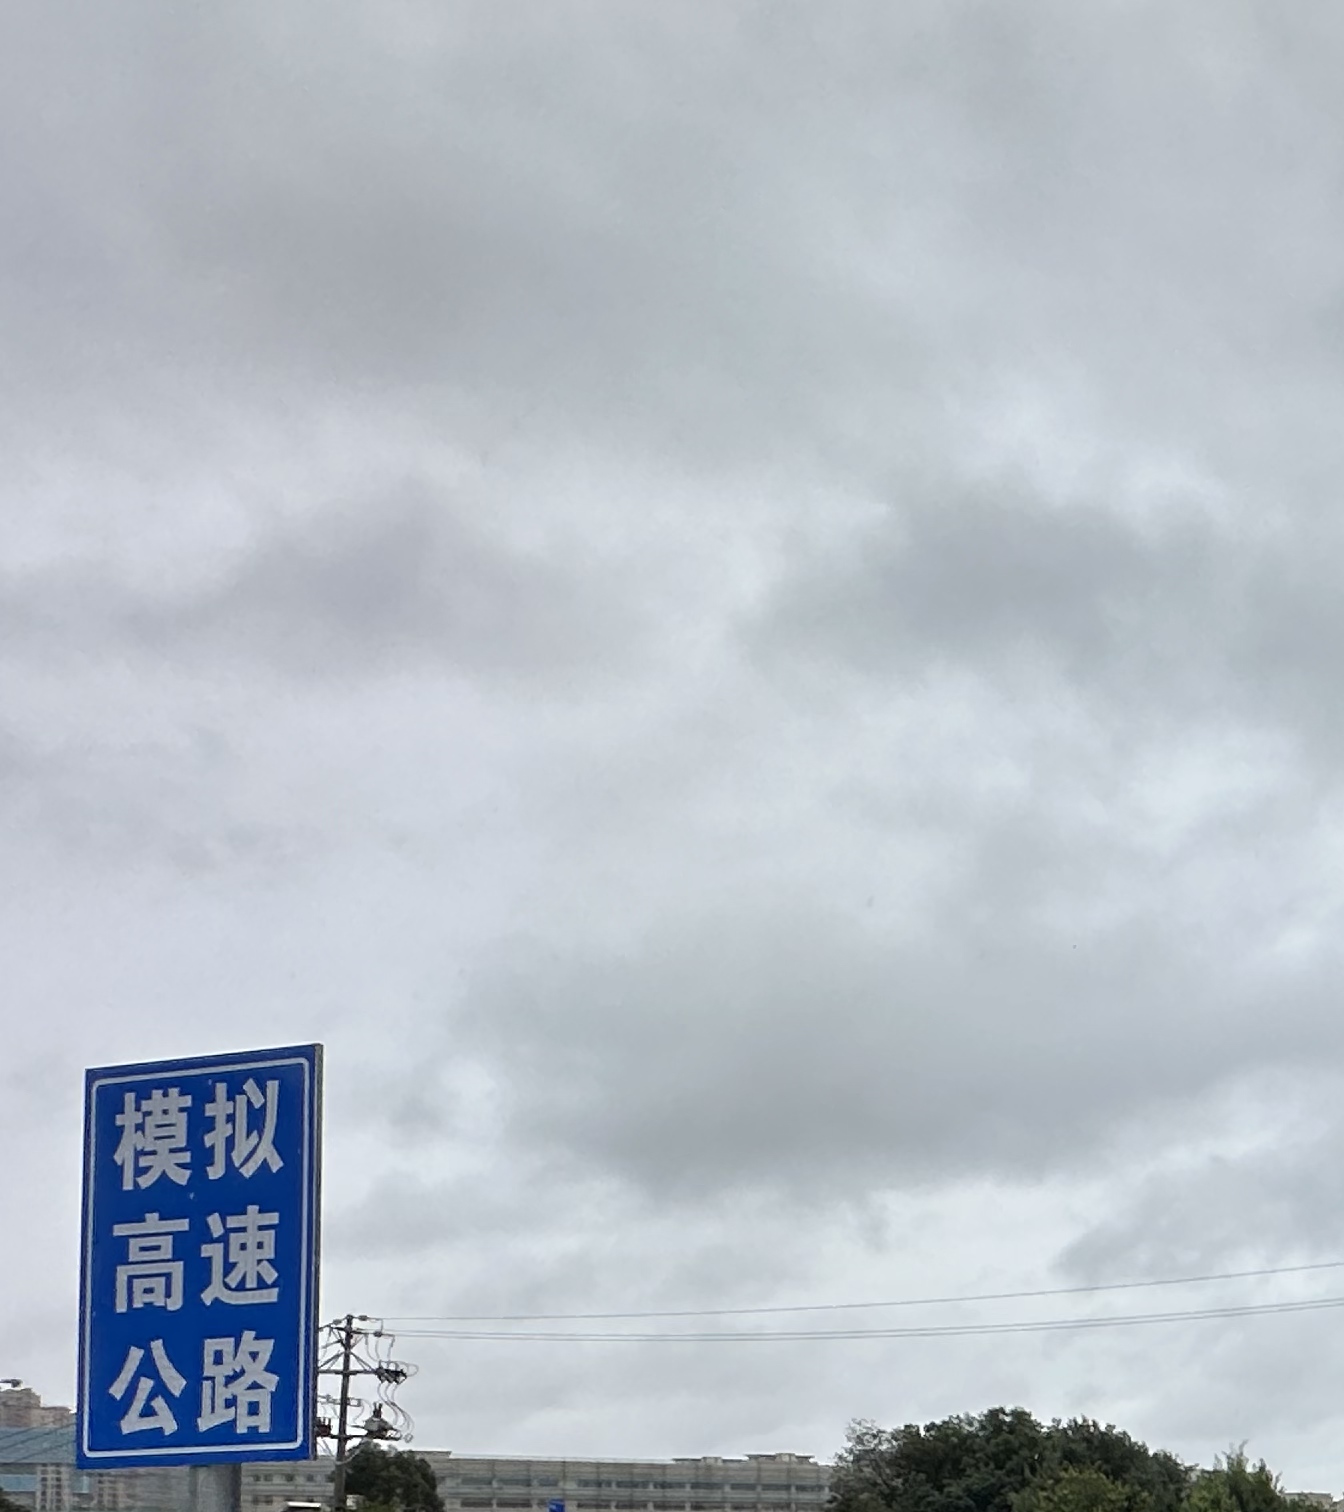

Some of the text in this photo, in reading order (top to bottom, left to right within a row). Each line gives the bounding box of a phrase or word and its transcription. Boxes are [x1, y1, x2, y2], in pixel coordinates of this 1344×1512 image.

[113, 1077, 285, 1191] 模拟
[111, 1204, 281, 1314] 高速
[108, 1329, 281, 1437] 公路
